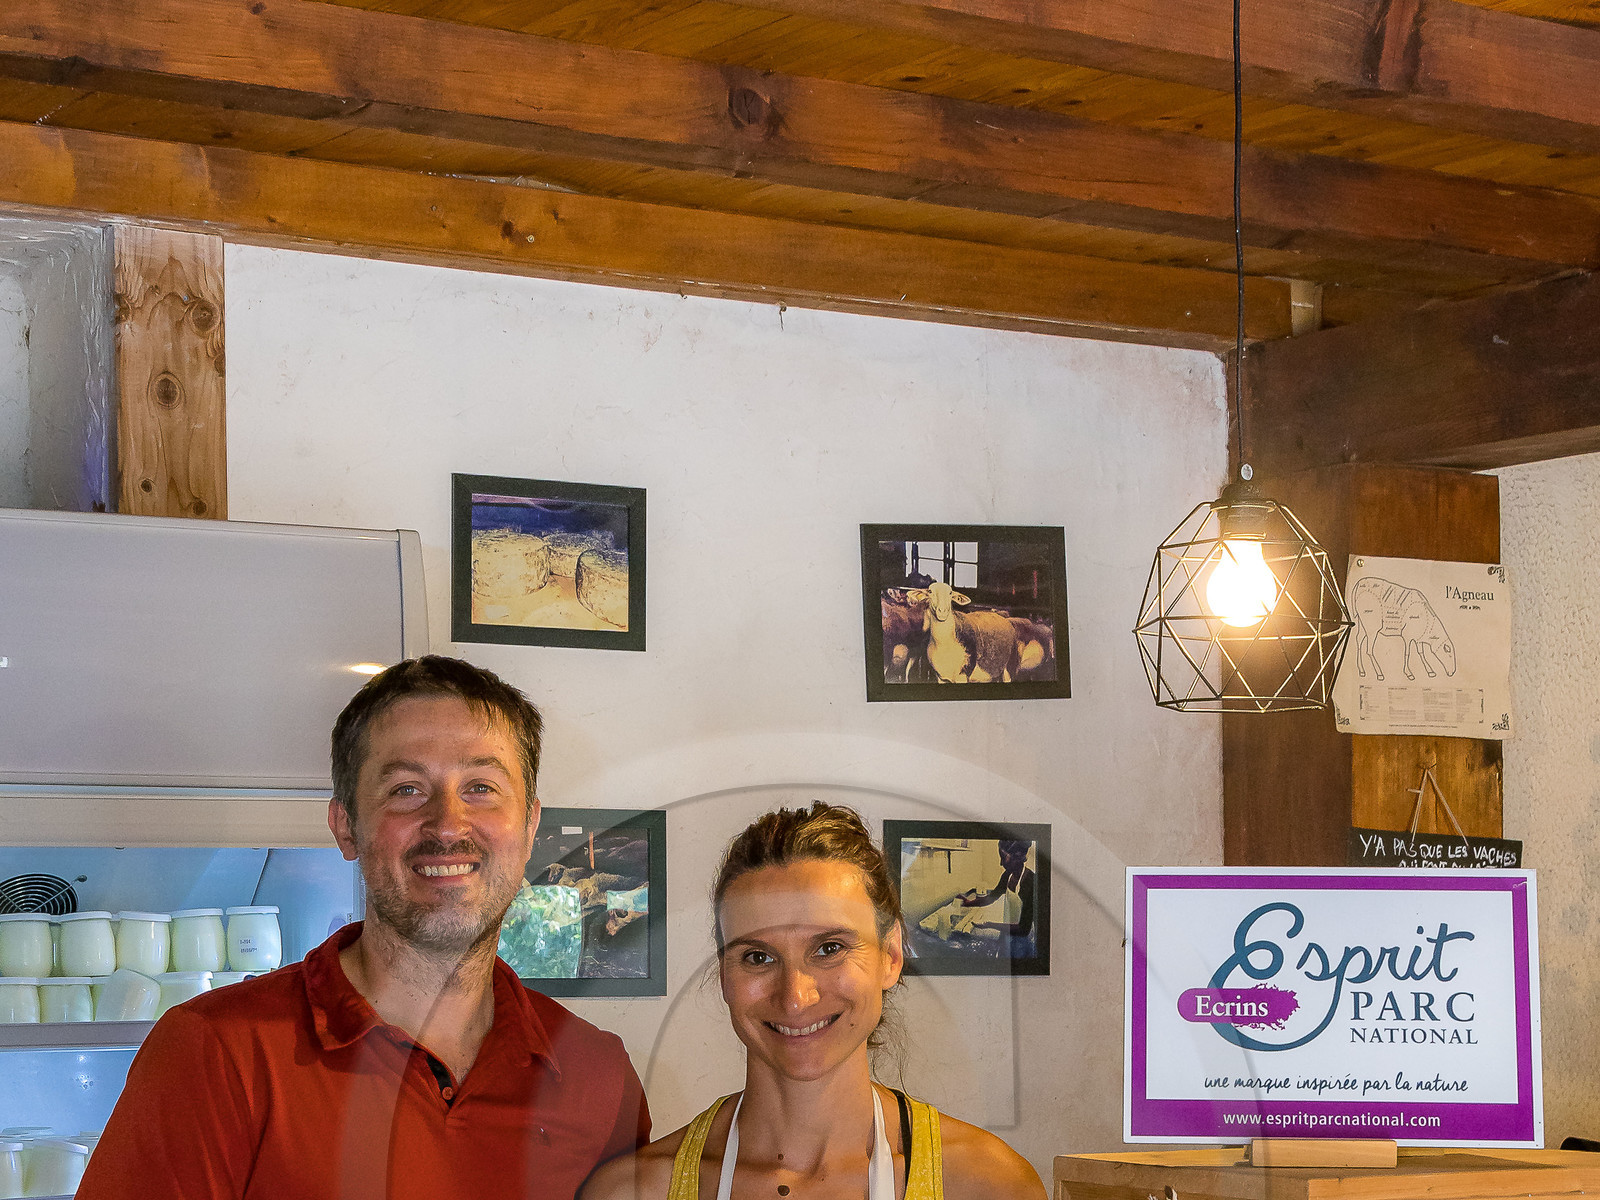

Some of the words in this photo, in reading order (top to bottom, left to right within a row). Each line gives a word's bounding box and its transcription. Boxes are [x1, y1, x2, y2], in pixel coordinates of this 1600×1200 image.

[1445, 585, 1495, 603] l'Agneau
[1359, 834, 1386, 858] Y'A
[1393, 838, 1418, 858] PAS
[1419, 844, 1443, 859] QUE
[1448, 845, 1468, 859] LES
[1473, 846, 1517, 867] VACHES
[1206, 902, 1475, 1052] Esprit
[1194, 995, 1269, 1017] Ecrins
[1350, 991, 1475, 1022] PARC
[1350, 1027, 1479, 1045] NATIONAL
[1204, 1077, 1230, 1088] une
[1234, 1077, 1291, 1094] marque
[1296, 1073, 1358, 1096] inspirée
[1362, 1079, 1391, 1096] par
[1395, 1071, 1413, 1091] la
[1416, 1073, 1469, 1091] nature
[1223, 1111, 1441, 1128] www.espritparcnational.com
